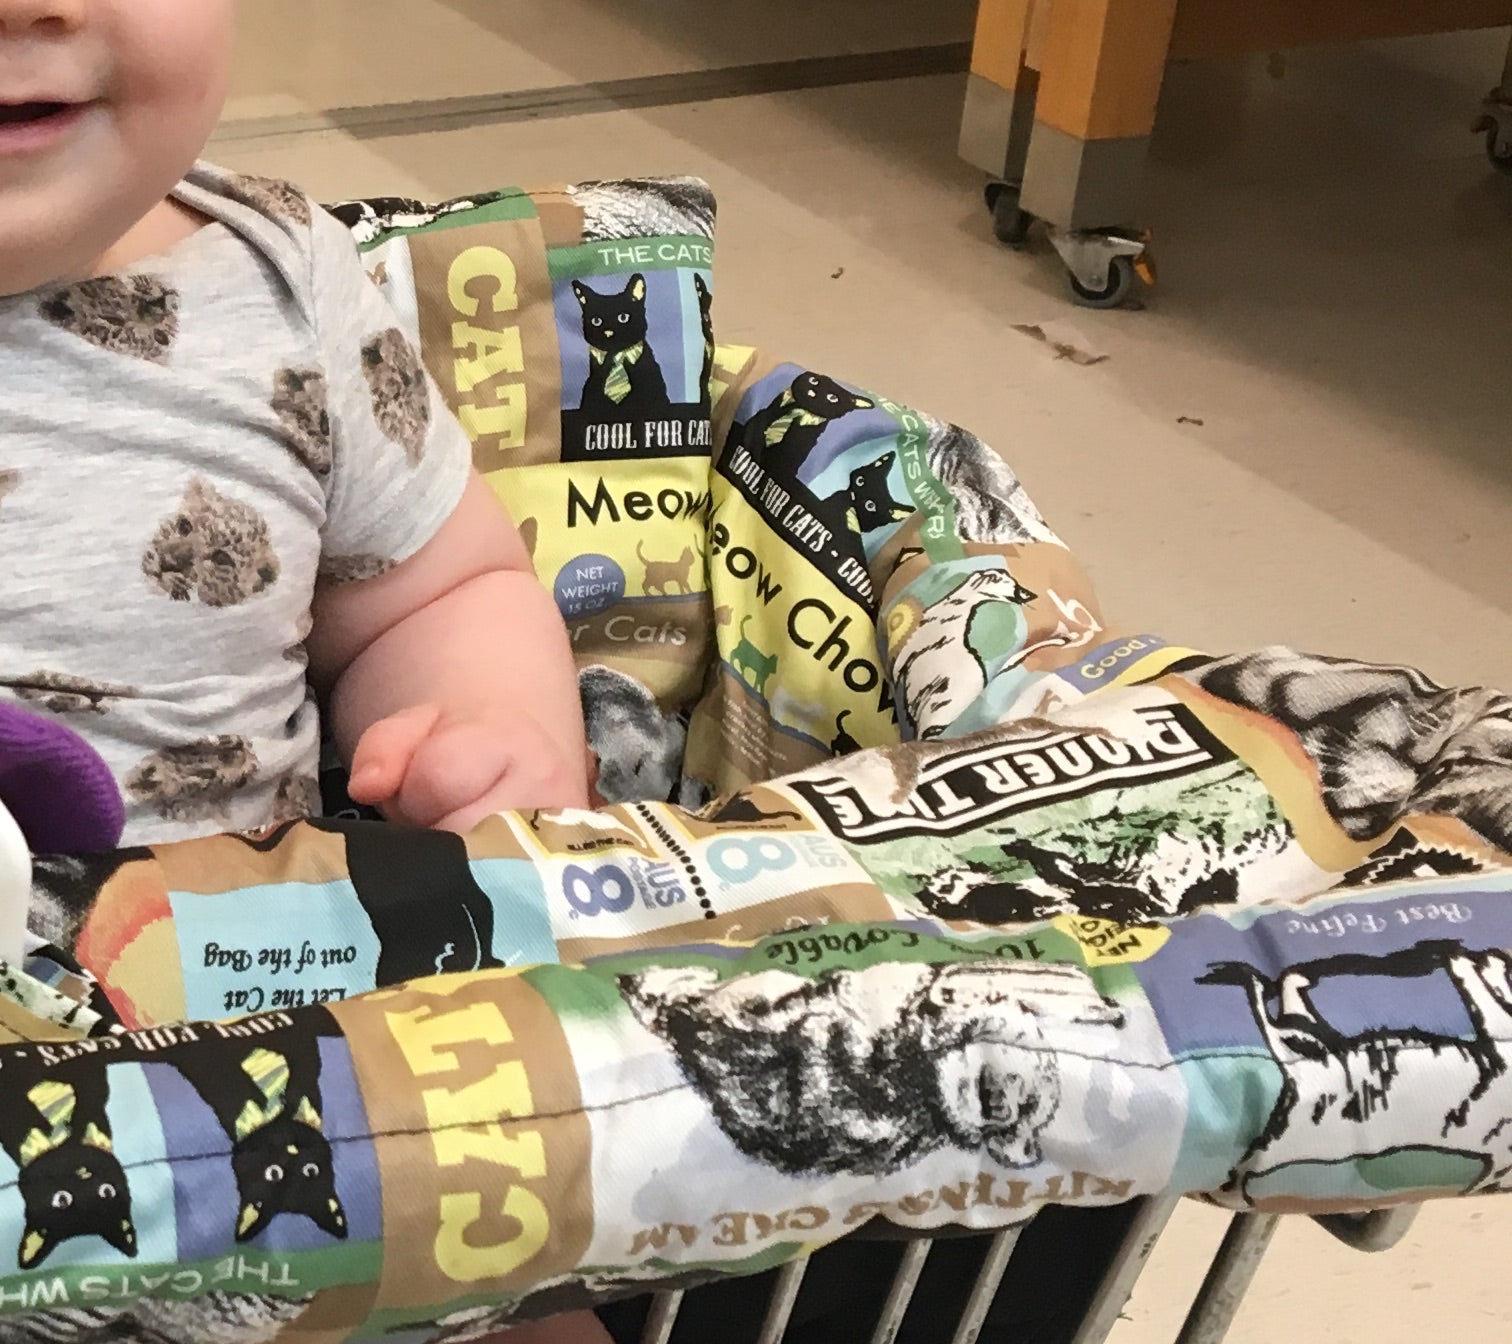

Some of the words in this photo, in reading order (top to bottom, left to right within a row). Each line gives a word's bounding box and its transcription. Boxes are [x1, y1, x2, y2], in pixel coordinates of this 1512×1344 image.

[597, 243, 653, 266] THE
[658, 242, 715, 265] CATS
[446, 246, 527, 450] CAT
[585, 423, 638, 451] COOL
[644, 422, 682, 449] FOR
[688, 419, 714, 447] CAT
[898, 413, 927, 485] CATS
[568, 477, 713, 529] Meow
[728, 446, 763, 498] COOL
[760, 476, 787, 524] FOR
[781, 494, 832, 555] CATS
[576, 566, 604, 582] NET
[712, 524, 783, 607] eow
[562, 582, 619, 600] WEIGHT
[605, 614, 687, 646] Cats
[638, 858, 687, 909] AUS
[1287, 907, 1388, 936] Feline
[1398, 901, 1473, 927] Best
[204, 941, 251, 968] Bag
[258, 944, 290, 969] the
[291, 940, 317, 969] of
[317, 946, 357, 965] out
[765, 926, 920, 967] Lovable
[224, 985, 256, 1012] Cat
[261, 985, 298, 1008] the
[385, 1002, 550, 1282] CAT
[79, 1269, 206, 1299] CATS
[216, 1260, 300, 1290] THE
